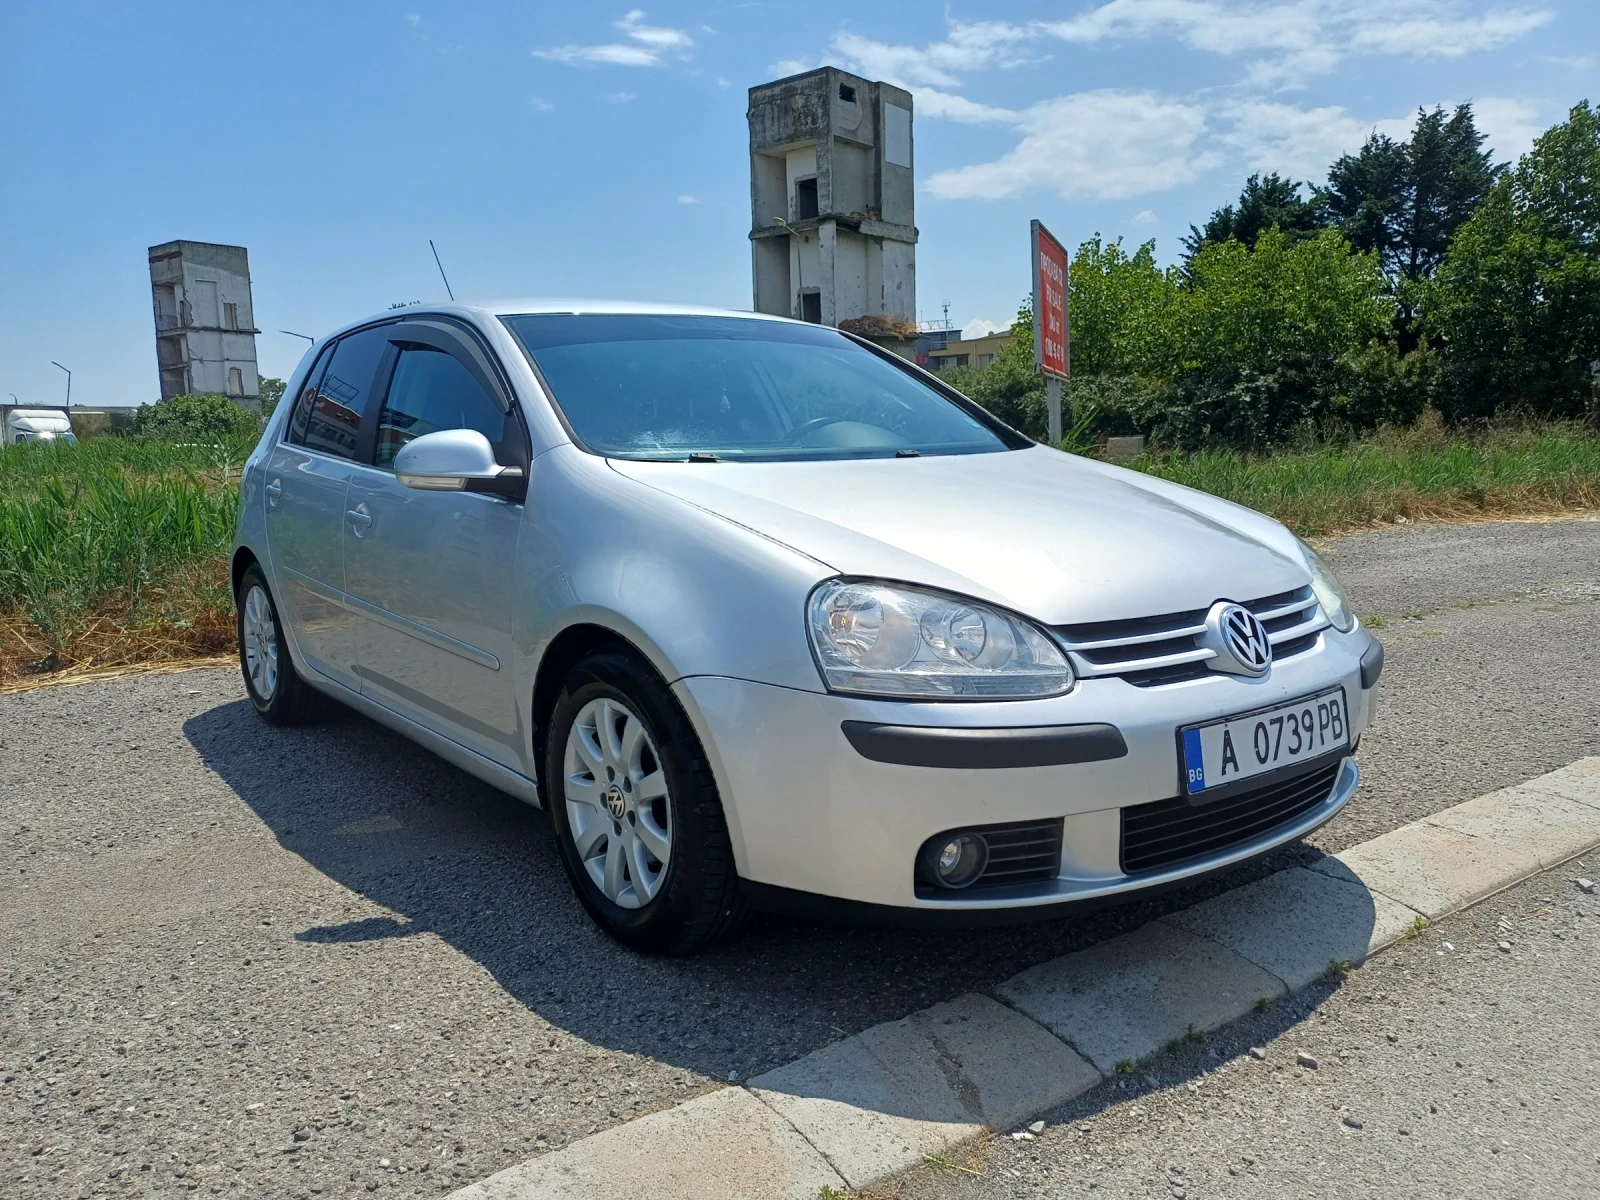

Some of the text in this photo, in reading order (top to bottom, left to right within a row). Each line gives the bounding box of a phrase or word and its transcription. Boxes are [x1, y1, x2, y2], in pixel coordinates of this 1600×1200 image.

[1221, 606, 1270, 668] VW
[1188, 767, 1203, 783] BG
[1221, 730, 1240, 776] A
